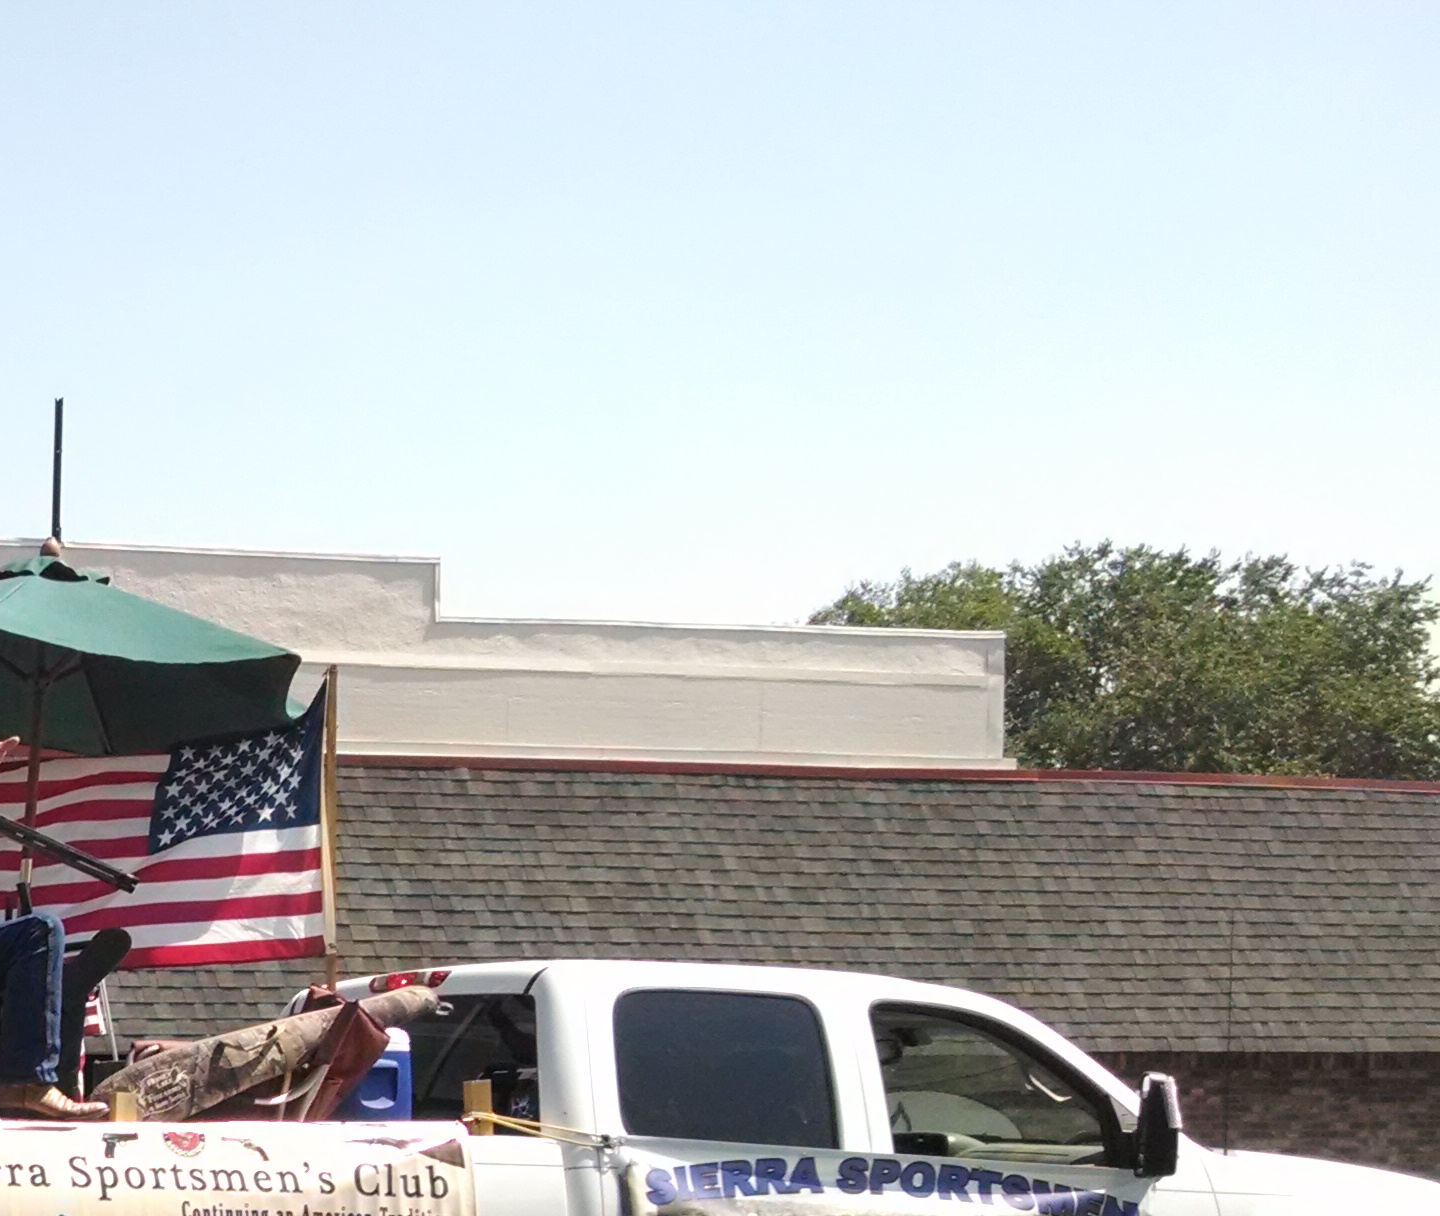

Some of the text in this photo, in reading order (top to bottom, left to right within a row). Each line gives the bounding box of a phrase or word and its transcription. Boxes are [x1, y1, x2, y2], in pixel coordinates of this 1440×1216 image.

[68, 1156, 336, 1201] Sportsmen's
[354, 1163, 449, 1199] Club
[645, 1156, 824, 1206] SIERRA
